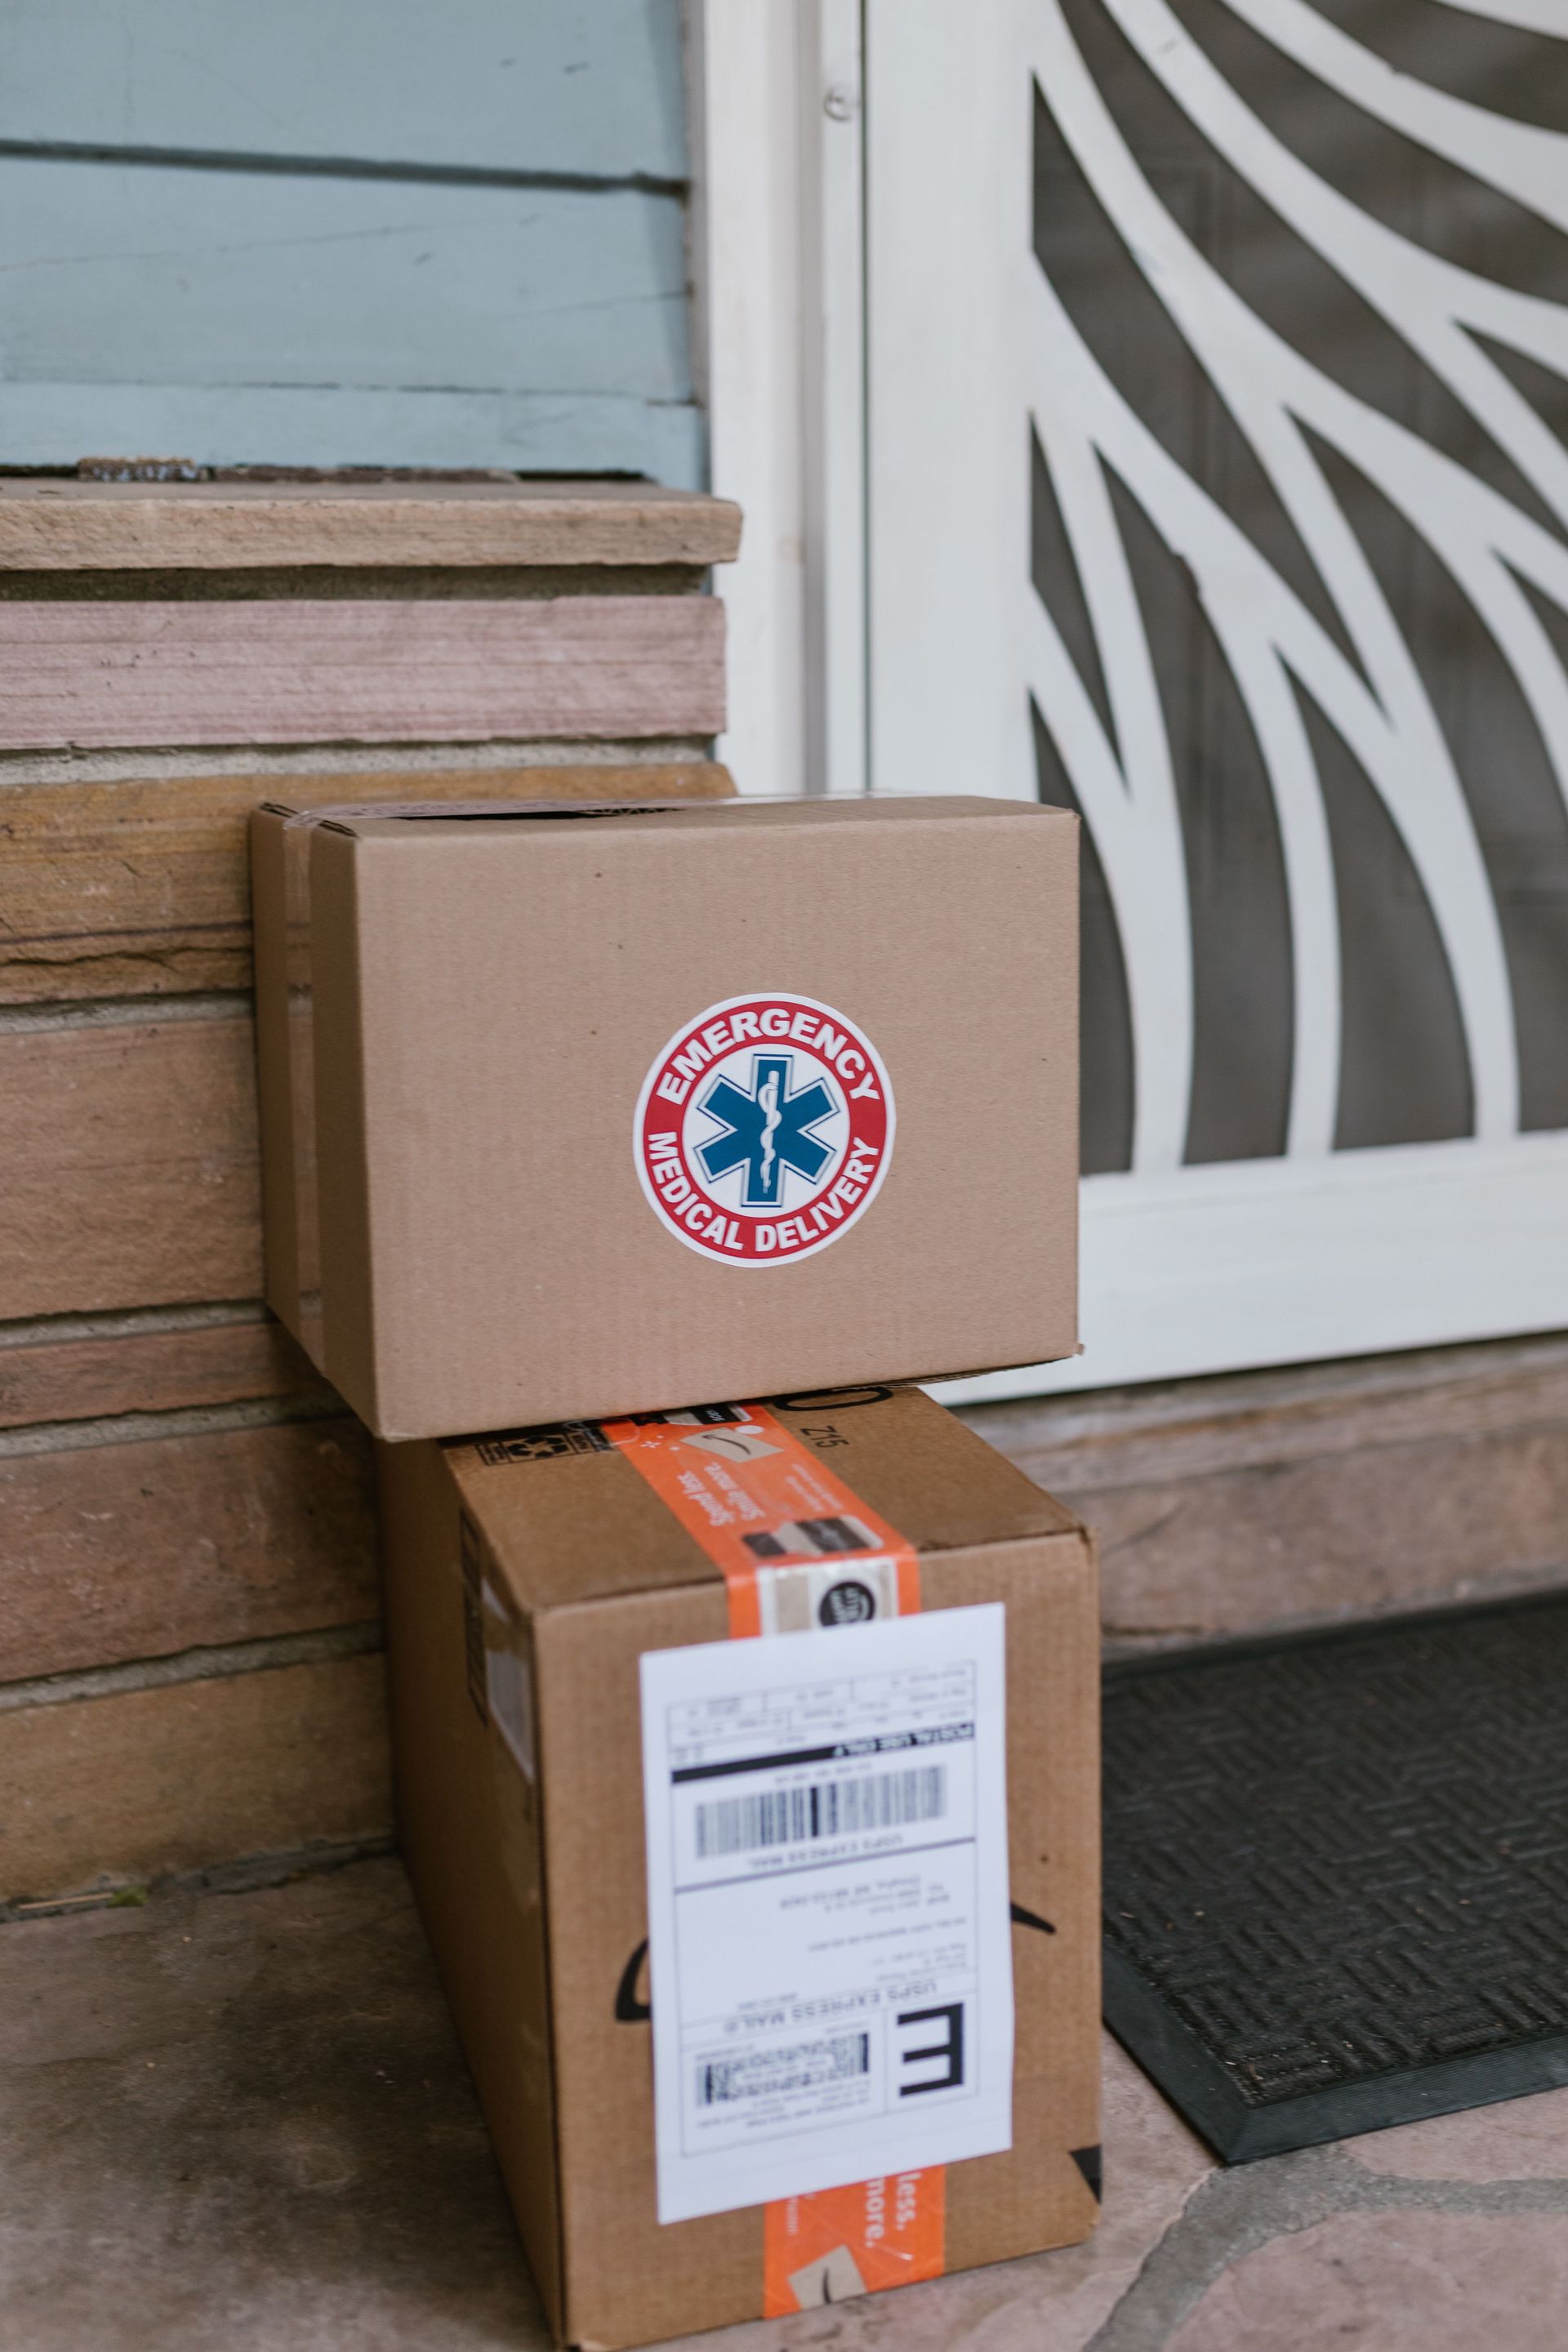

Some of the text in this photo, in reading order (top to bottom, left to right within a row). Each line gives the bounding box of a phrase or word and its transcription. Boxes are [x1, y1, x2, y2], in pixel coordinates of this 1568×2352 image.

[656, 1008, 881, 1106] EMERGENCY
[648, 1130, 880, 1252] MEDICAL DELIVERY
[792, 1989, 881, 2020] EXPRESS
[887, 1978, 937, 2000] USPS
[897, 2001, 964, 2098] E
[896, 2172, 923, 2232] less.
